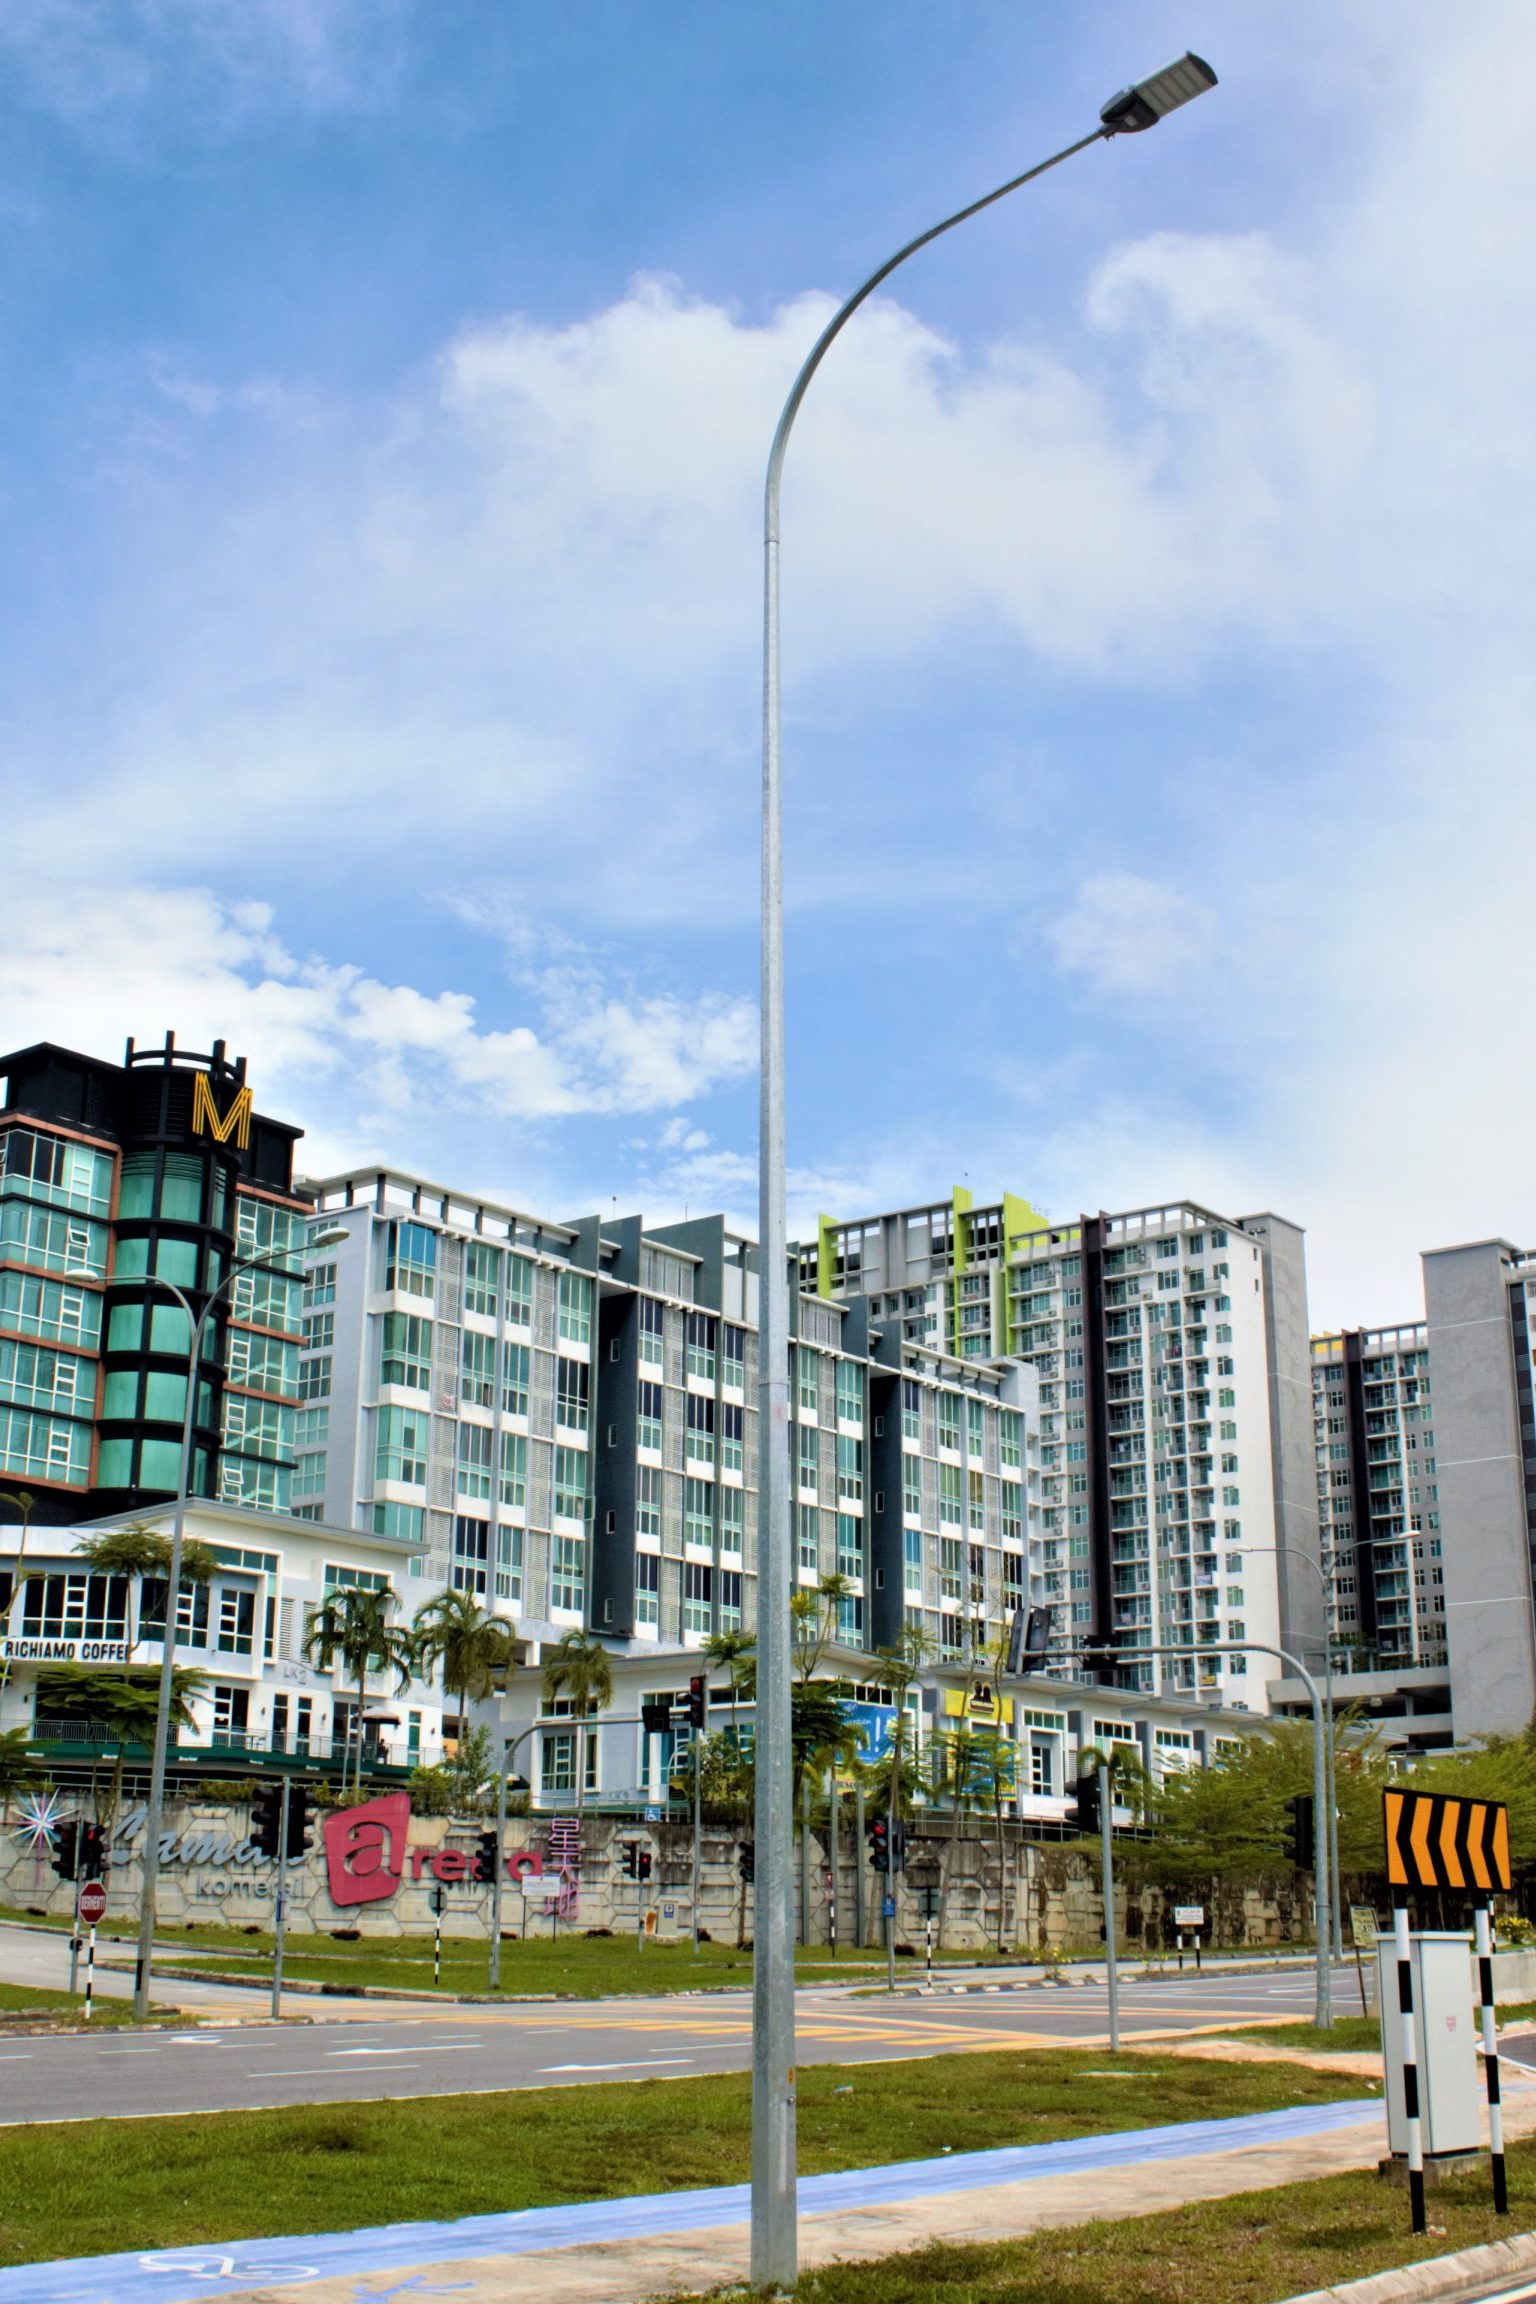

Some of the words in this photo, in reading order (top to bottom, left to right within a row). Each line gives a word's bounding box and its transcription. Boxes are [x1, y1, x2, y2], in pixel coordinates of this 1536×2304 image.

[192, 1071, 254, 1151] M
[5, 1641, 75, 1658] RICHIAMO
[283, 1664, 307, 1685] LK2
[340, 1817, 544, 1884] area
